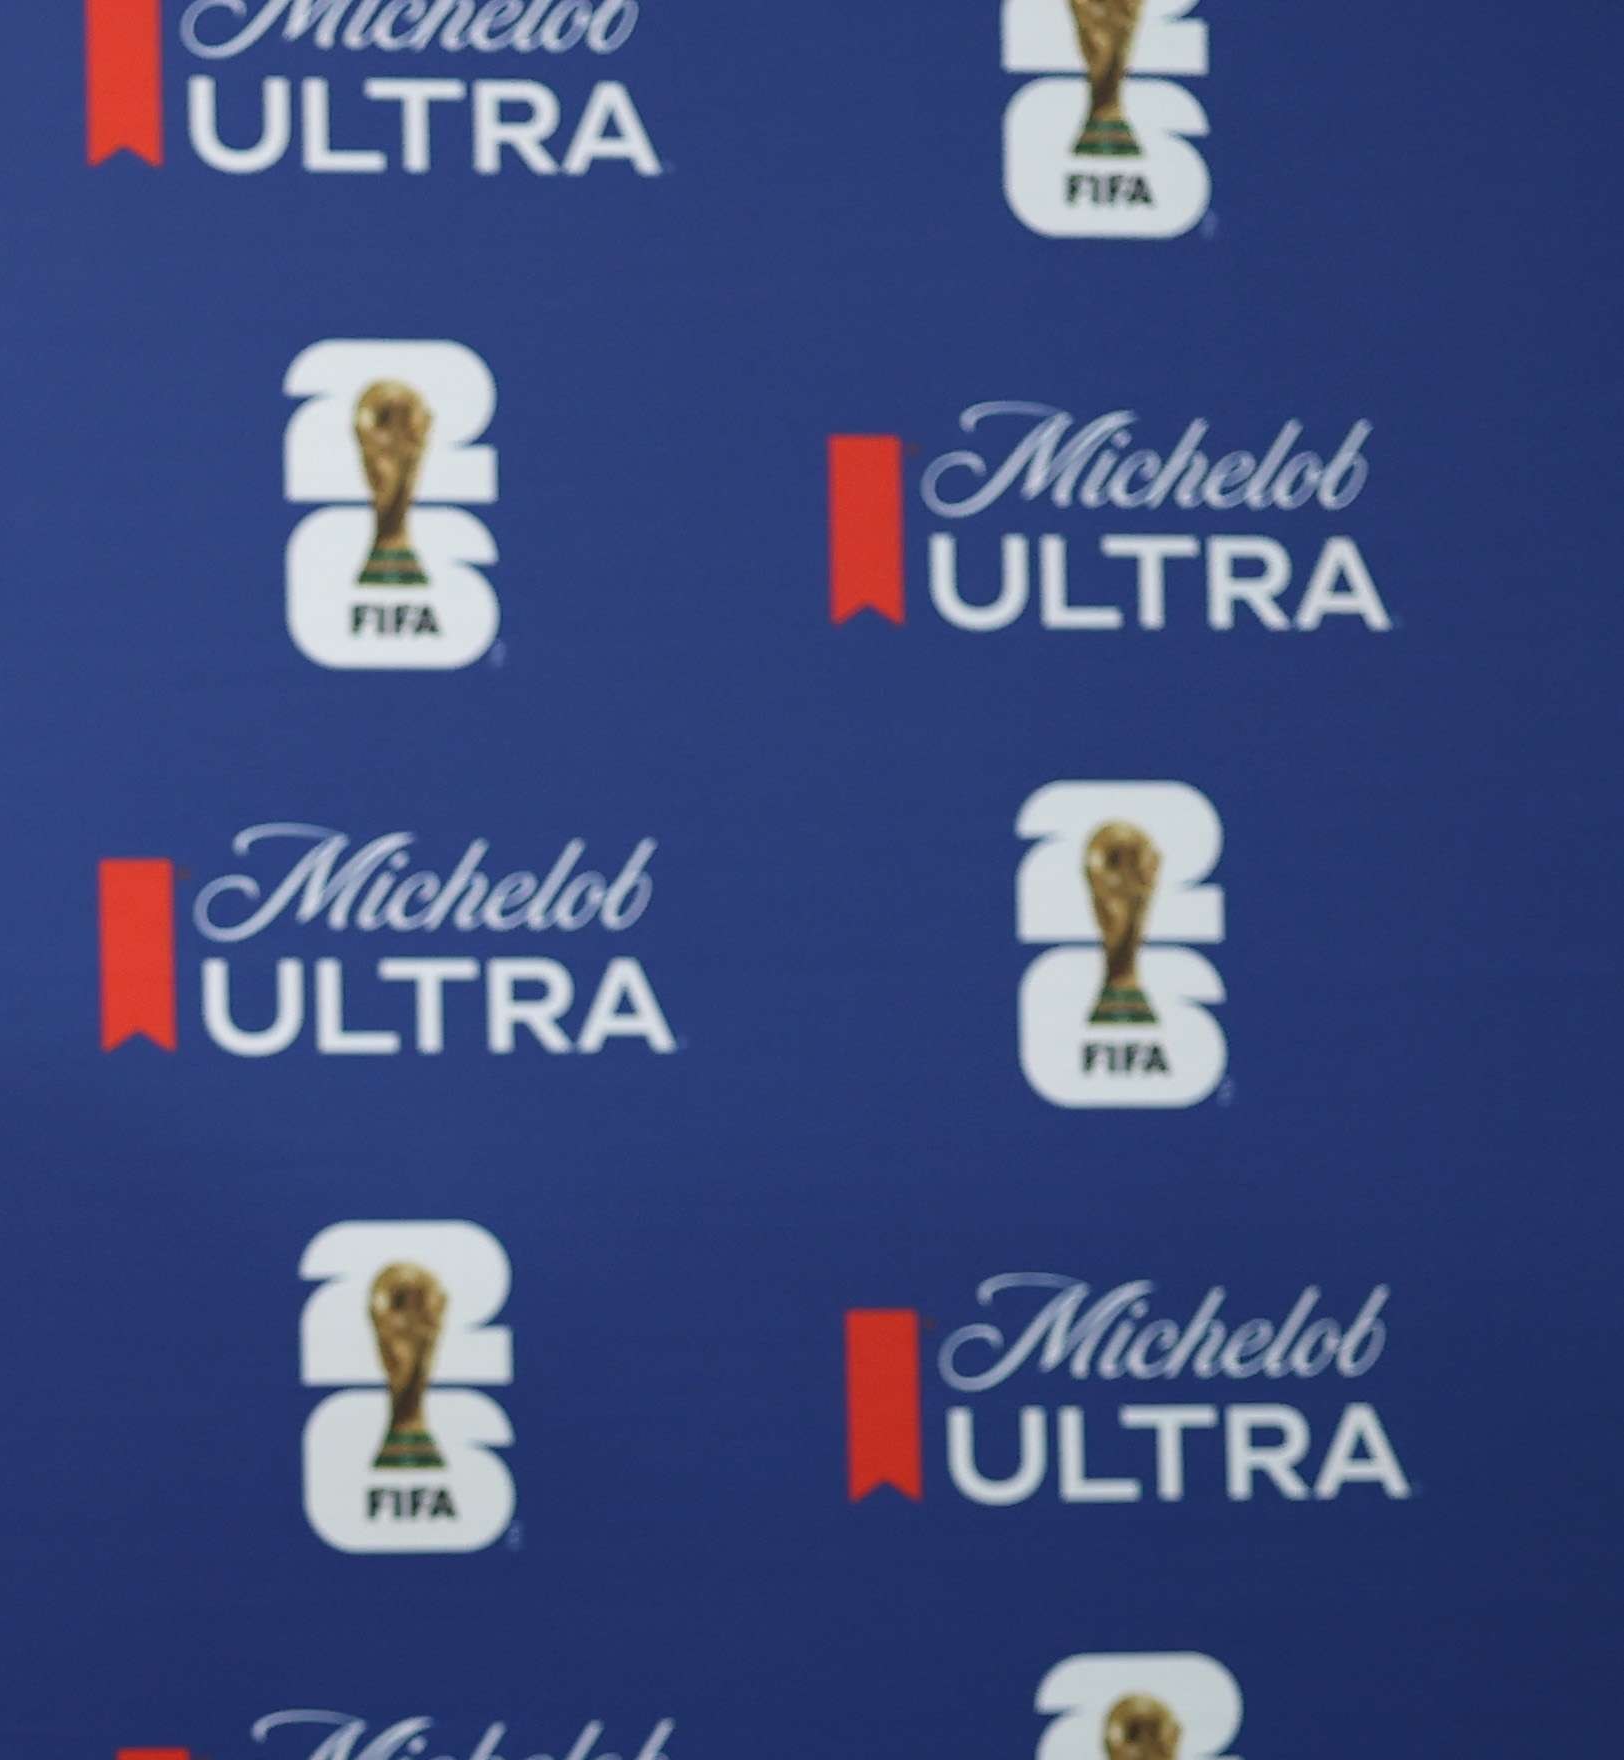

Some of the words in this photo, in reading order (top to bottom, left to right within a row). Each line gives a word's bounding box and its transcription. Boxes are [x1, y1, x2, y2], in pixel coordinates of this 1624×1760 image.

[189, 76, 660, 175] ULTRA
[1067, 175, 1152, 204] FIFA
[921, 401, 1372, 518] Michelob
[352, 605, 439, 634] FIFA
[930, 534, 1389, 630] ULTRA
[194, 823, 656, 942] Michelob
[203, 958, 674, 1056] ULTRA
[1083, 1044, 1168, 1072] FIFA
[939, 1273, 1388, 1391] Michelob
[368, 1488, 455, 1517] FIFA
[948, 1404, 1408, 1505] ULTRA
